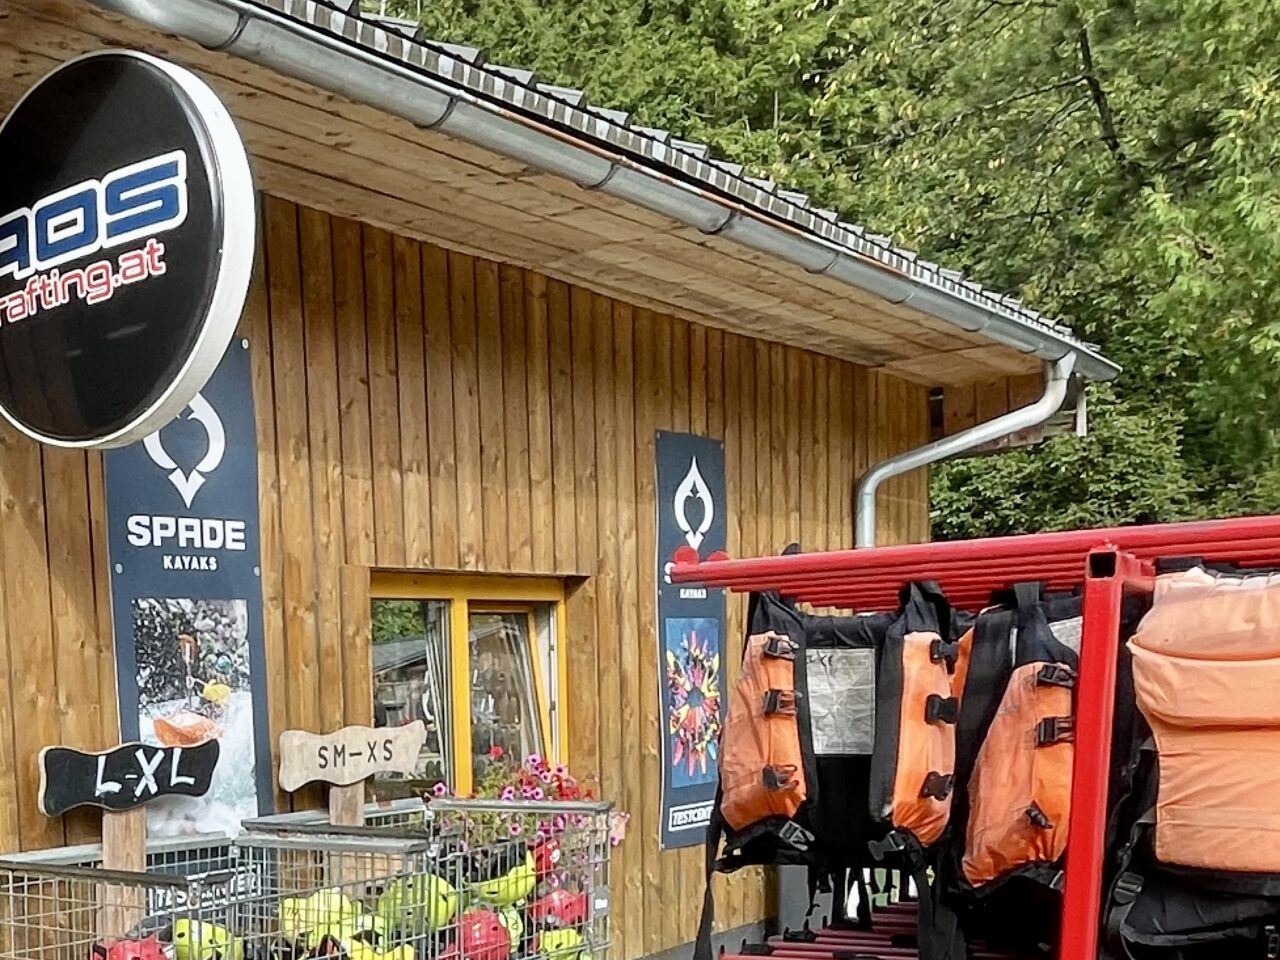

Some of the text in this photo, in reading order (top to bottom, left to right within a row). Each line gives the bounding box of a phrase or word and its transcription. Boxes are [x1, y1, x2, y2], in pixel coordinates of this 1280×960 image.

[126, 514, 246, 551] SPADE
[163, 555, 218, 571] KAYAKS
[317, 739, 394, 769] SM-XS
[95, 747, 196, 798] L-XL
